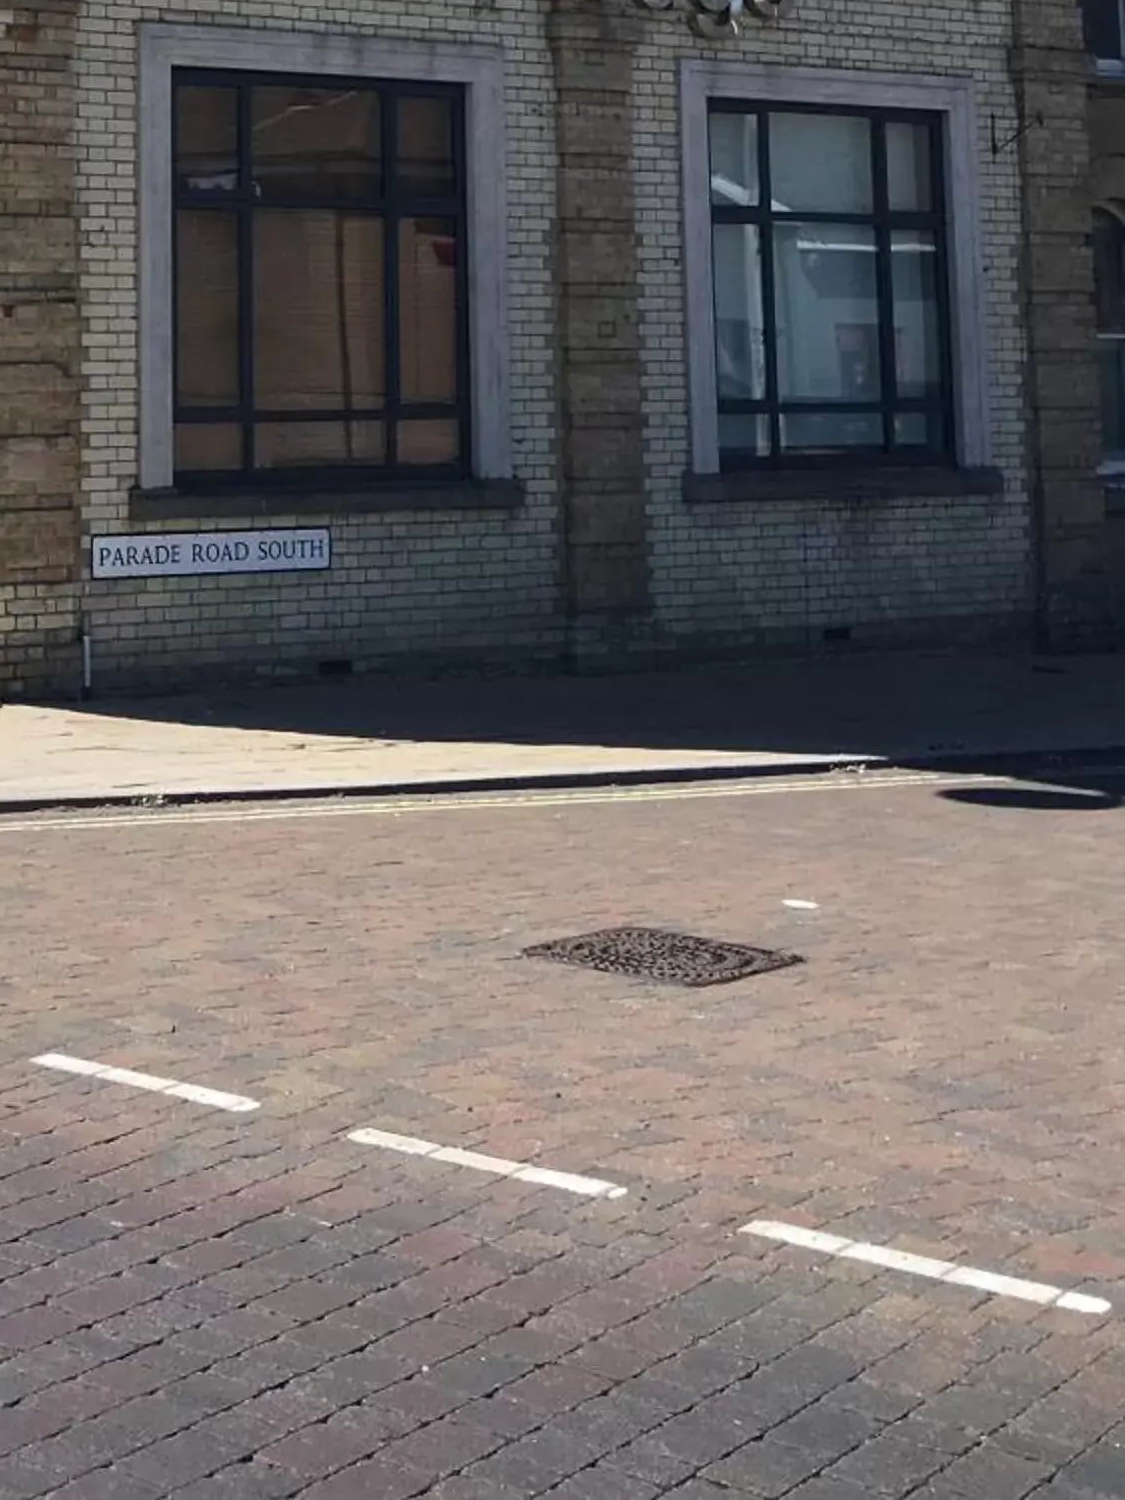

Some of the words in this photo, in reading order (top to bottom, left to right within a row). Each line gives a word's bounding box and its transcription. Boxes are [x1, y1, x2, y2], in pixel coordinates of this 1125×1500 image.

[98, 544, 181, 567] PARADE
[191, 541, 250, 563] ROAD
[257, 538, 324, 560] SOUTH
